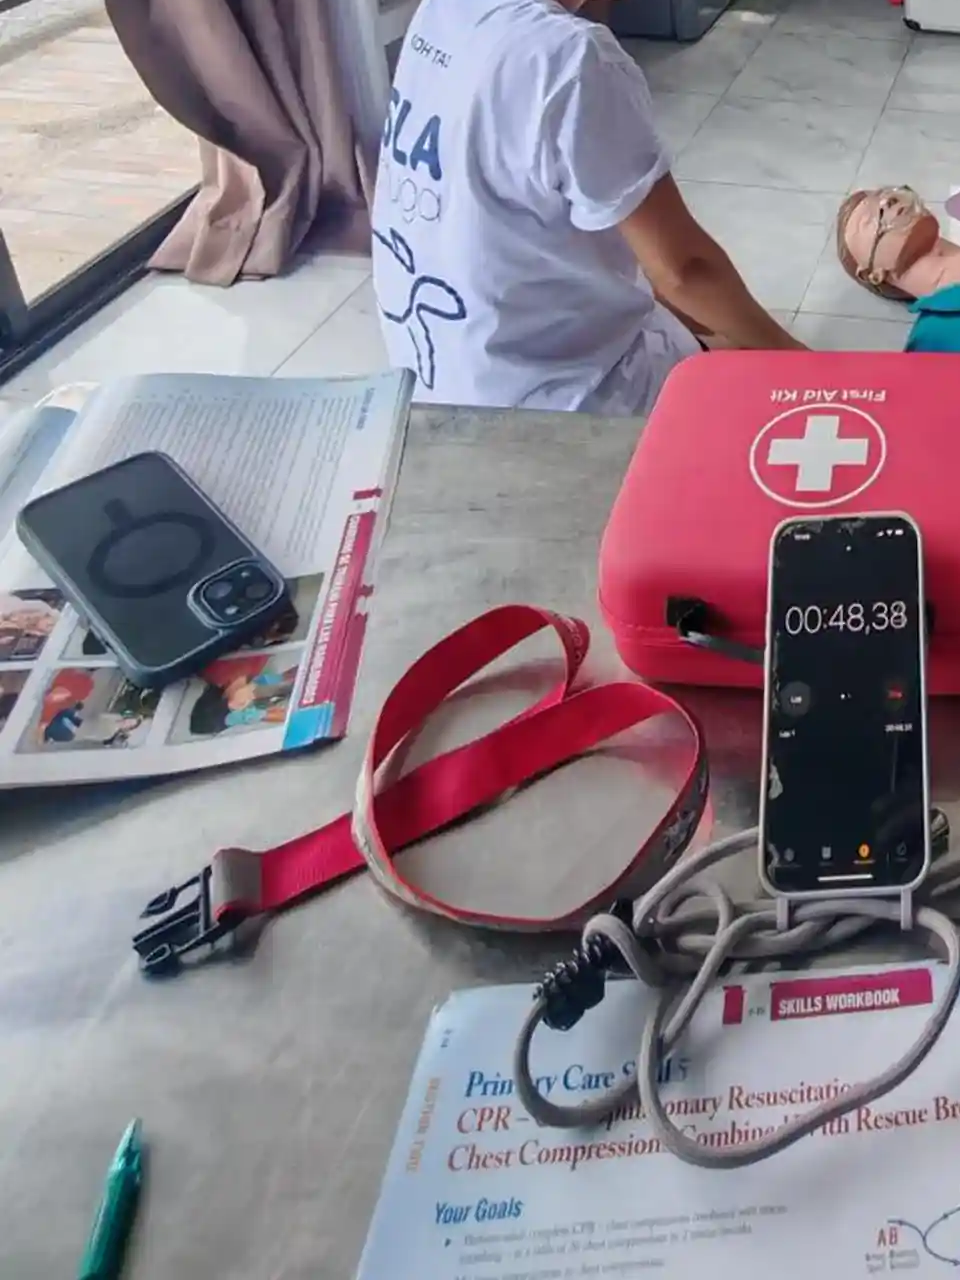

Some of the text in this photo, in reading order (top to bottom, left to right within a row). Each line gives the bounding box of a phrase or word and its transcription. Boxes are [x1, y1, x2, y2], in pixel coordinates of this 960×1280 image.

[770, 389, 886, 402] First Aid Kit
[785, 601, 907, 636] 00:48,38
[778, 995, 823, 1015] SKILLS
[826, 988, 900, 1011] WORKBOOK
[465, 1069, 557, 1098] Primry
[562, 1063, 616, 1092] Care
[457, 1105, 511, 1135] CPR
[728, 1077, 858, 1111] Resuscitatio
[447, 1143, 512, 1172] Chest
[519, 1134, 664, 1172] Compression
[856, 1107, 929, 1133] Rescue
[436, 1201, 472, 1225] Your
[474, 1196, 524, 1222] Goals
